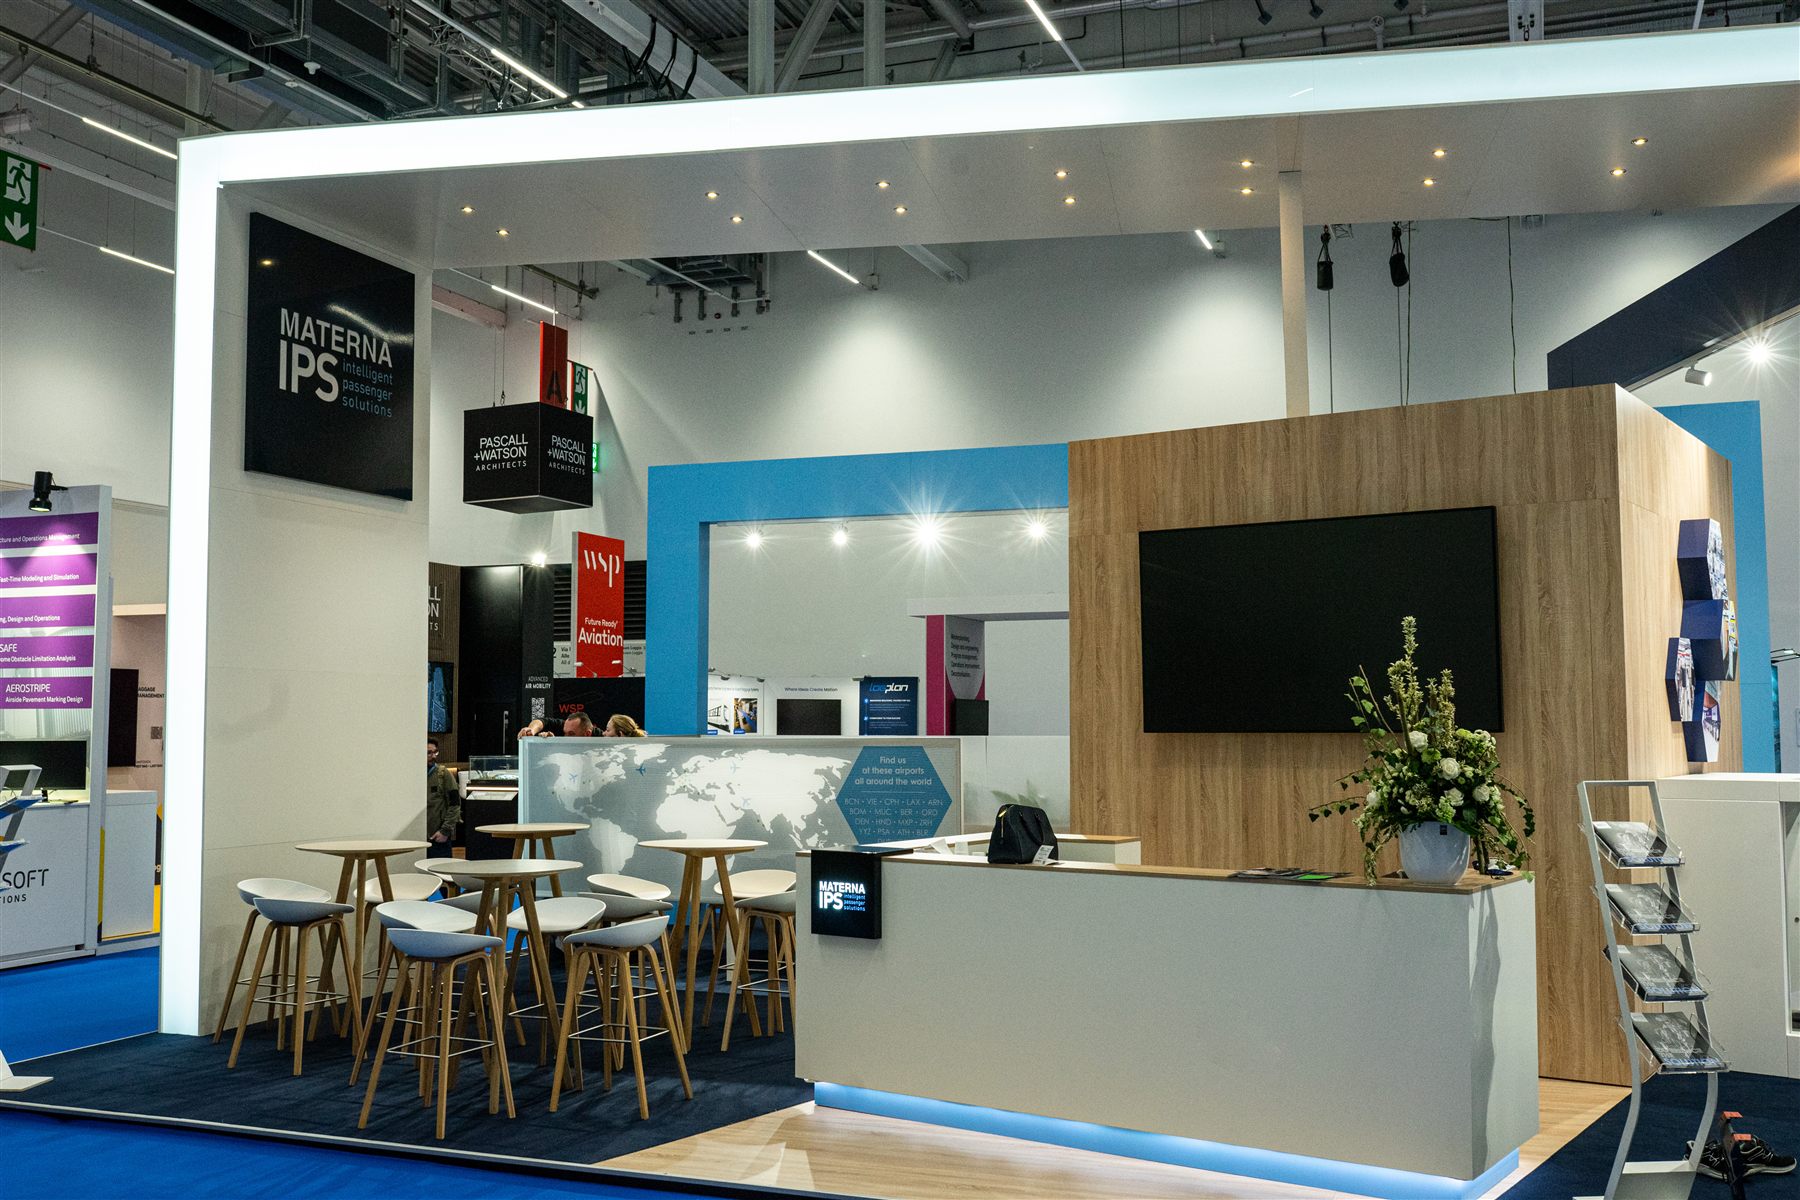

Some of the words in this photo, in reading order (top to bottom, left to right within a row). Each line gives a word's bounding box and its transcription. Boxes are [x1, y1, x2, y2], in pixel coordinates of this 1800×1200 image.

[280, 307, 393, 368] MATERNA
[279, 338, 339, 402] IPS
[342, 358, 393, 385] intelligent
[342, 379, 392, 402] passenger
[342, 396, 392, 418] solutions
[479, 433, 528, 449] PASCALL
[551, 434, 586, 454] PASCALL
[474, 446, 527, 461] +WATSON
[547, 447, 586, 466] +WATSON
[476, 460, 527, 472] ARCHITECTS
[548, 461, 586, 476] ARCHITECTS
[22, 534, 48, 542] Operations
[8, 616, 24, 624] Design
[584, 617, 601, 626] Future
[578, 627, 623, 647] Aviation
[5, 683, 51, 693] AEROSTRIPE
[559, 704, 584, 713] WSP
[895, 767, 925, 776] airports
[2, 868, 49, 889] SOFT
[819, 881, 866, 894] MATERNA
[819, 891, 843, 910] IPS
